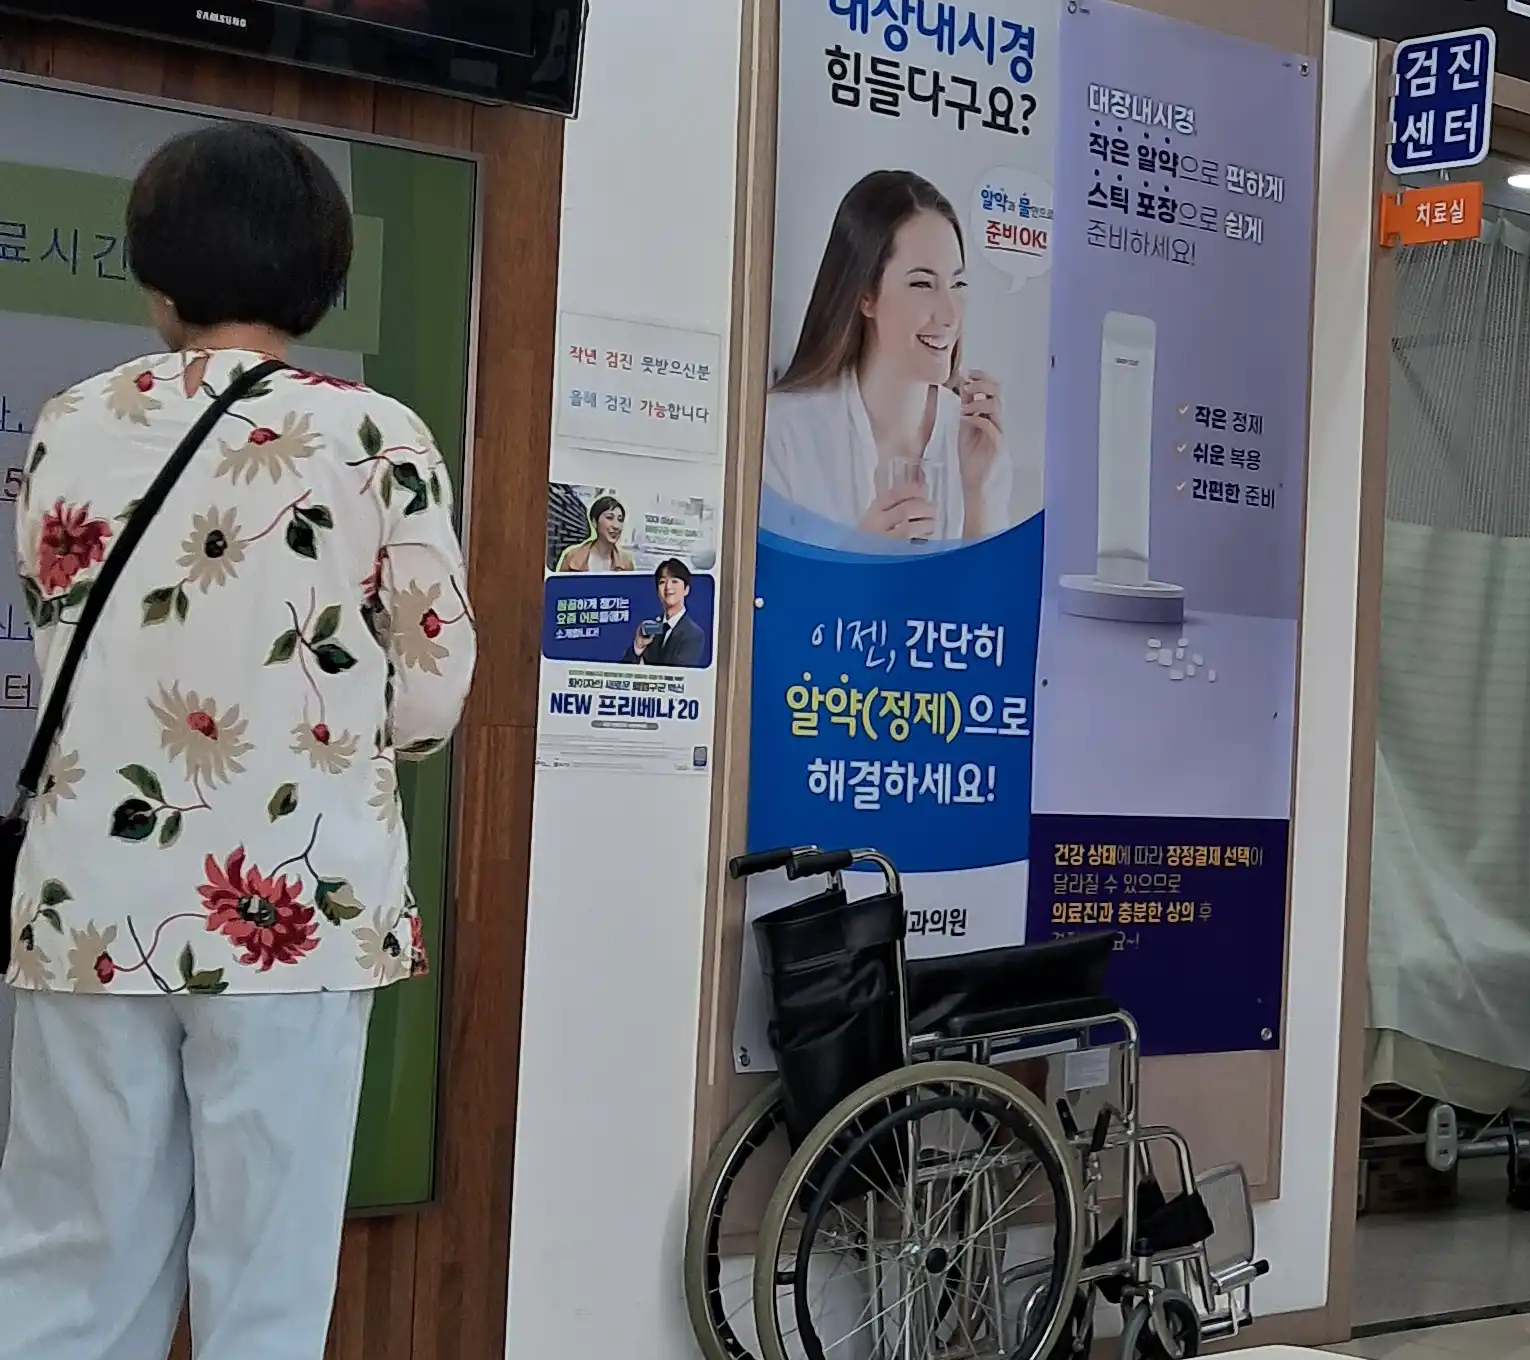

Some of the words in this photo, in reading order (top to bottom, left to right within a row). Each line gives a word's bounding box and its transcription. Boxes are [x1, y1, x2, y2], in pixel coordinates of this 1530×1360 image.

[196, 8, 247, 28] SAMSUNG
[1404, 39, 1481, 98] 검진
[824, 44, 1038, 136] 힘들다구요?
[1399, 103, 1479, 160] 센터
[1089, 132, 1130, 166] 작은
[1137, 143, 1220, 187] 알약으로
[1226, 164, 1285, 203] 편하게
[1087, 181, 1130, 214] 스틱
[1136, 189, 1219, 233] 포장으로
[1224, 211, 1264, 244] 쉽게
[1415, 198, 1465, 227] 치료실
[1087, 219, 1196, 266] 준비하세요!
[569, 345, 597, 365] 작년
[605, 351, 633, 370] 검진
[641, 356, 711, 381] 못받으신분
[604, 394, 632, 413] 검진
[640, 399, 710, 423] 가능합니다
[1194, 405, 1227, 431] 작은
[1232, 411, 1263, 435] 정제
[1193, 442, 1225, 466] 쉬운
[1230, 447, 1261, 471] 복용
[1192, 478, 1241, 504] 간편한
[1245, 485, 1275, 509] 준비
[811, 617, 896, 673] 이젠,
[905, 619, 1005, 670] 간단히
[550, 692, 592, 715] NEW
[786, 684, 1031, 744] 알약(정제)으로
[807, 757, 997, 810] 해결하세요!
[1054, 844, 1084, 866] 건강
[1087, 844, 1131, 866] 상태에
[1134, 845, 1163, 866] 따라
[1166, 845, 1221, 867] 장정결제
[1223, 846, 1263, 868] 선택이
[1053, 873, 1099, 895] 달라질
[1104, 874, 1119, 894] 수
[1123, 873, 1182, 894] 있으므로
[904, 908, 967, 936] 과의원
[1051, 902, 1113, 924] 의료진과
[1118, 902, 1163, 923] 충분한
[1166, 902, 1195, 923] 상의
[1198, 901, 1213, 923] 후
